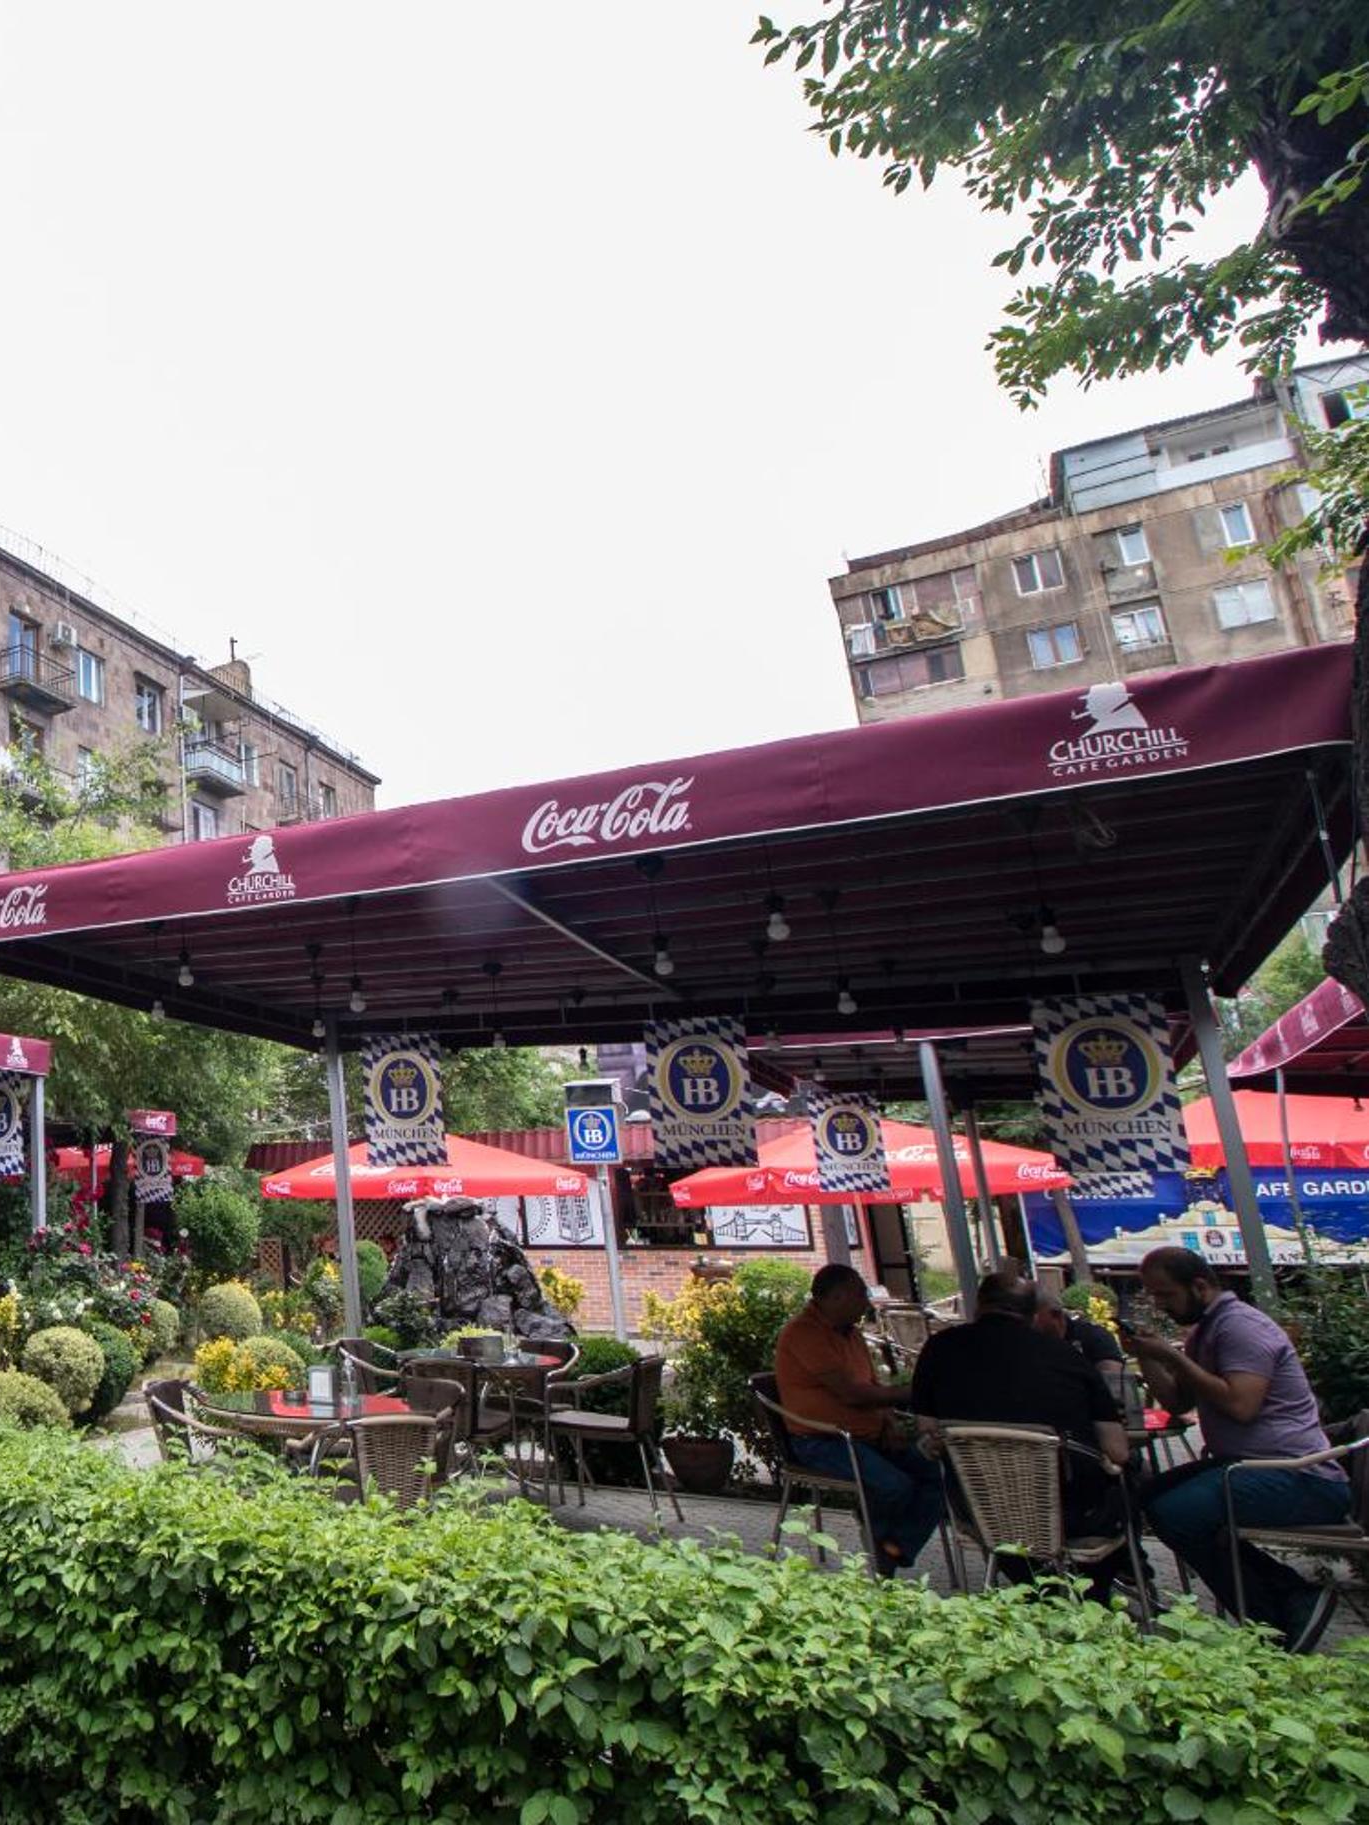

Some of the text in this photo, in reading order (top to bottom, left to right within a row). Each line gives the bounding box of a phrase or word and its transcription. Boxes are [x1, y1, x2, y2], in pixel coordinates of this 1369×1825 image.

[1049, 727, 1185, 763] CHURCHILL
[1052, 746, 1188, 776] CAFE GARDEN
[521, 776, 695, 853] Coca-Cola
[227, 874, 295, 892] CHURCHILL
[682, 1078, 720, 1105] HB
[1084, 1066, 1136, 1098] HB
[390, 1087, 419, 1112] HB
[374, 1126, 439, 1139] MÜNCHEN
[584, 1129, 603, 1143] HB
[663, 1119, 745, 1136] MÜNCHEN
[1062, 1116, 1172, 1137] MÜNCHEN
[835, 1132, 862, 1150] HB
[1256, 1181, 1369, 1197] AFE GARD
